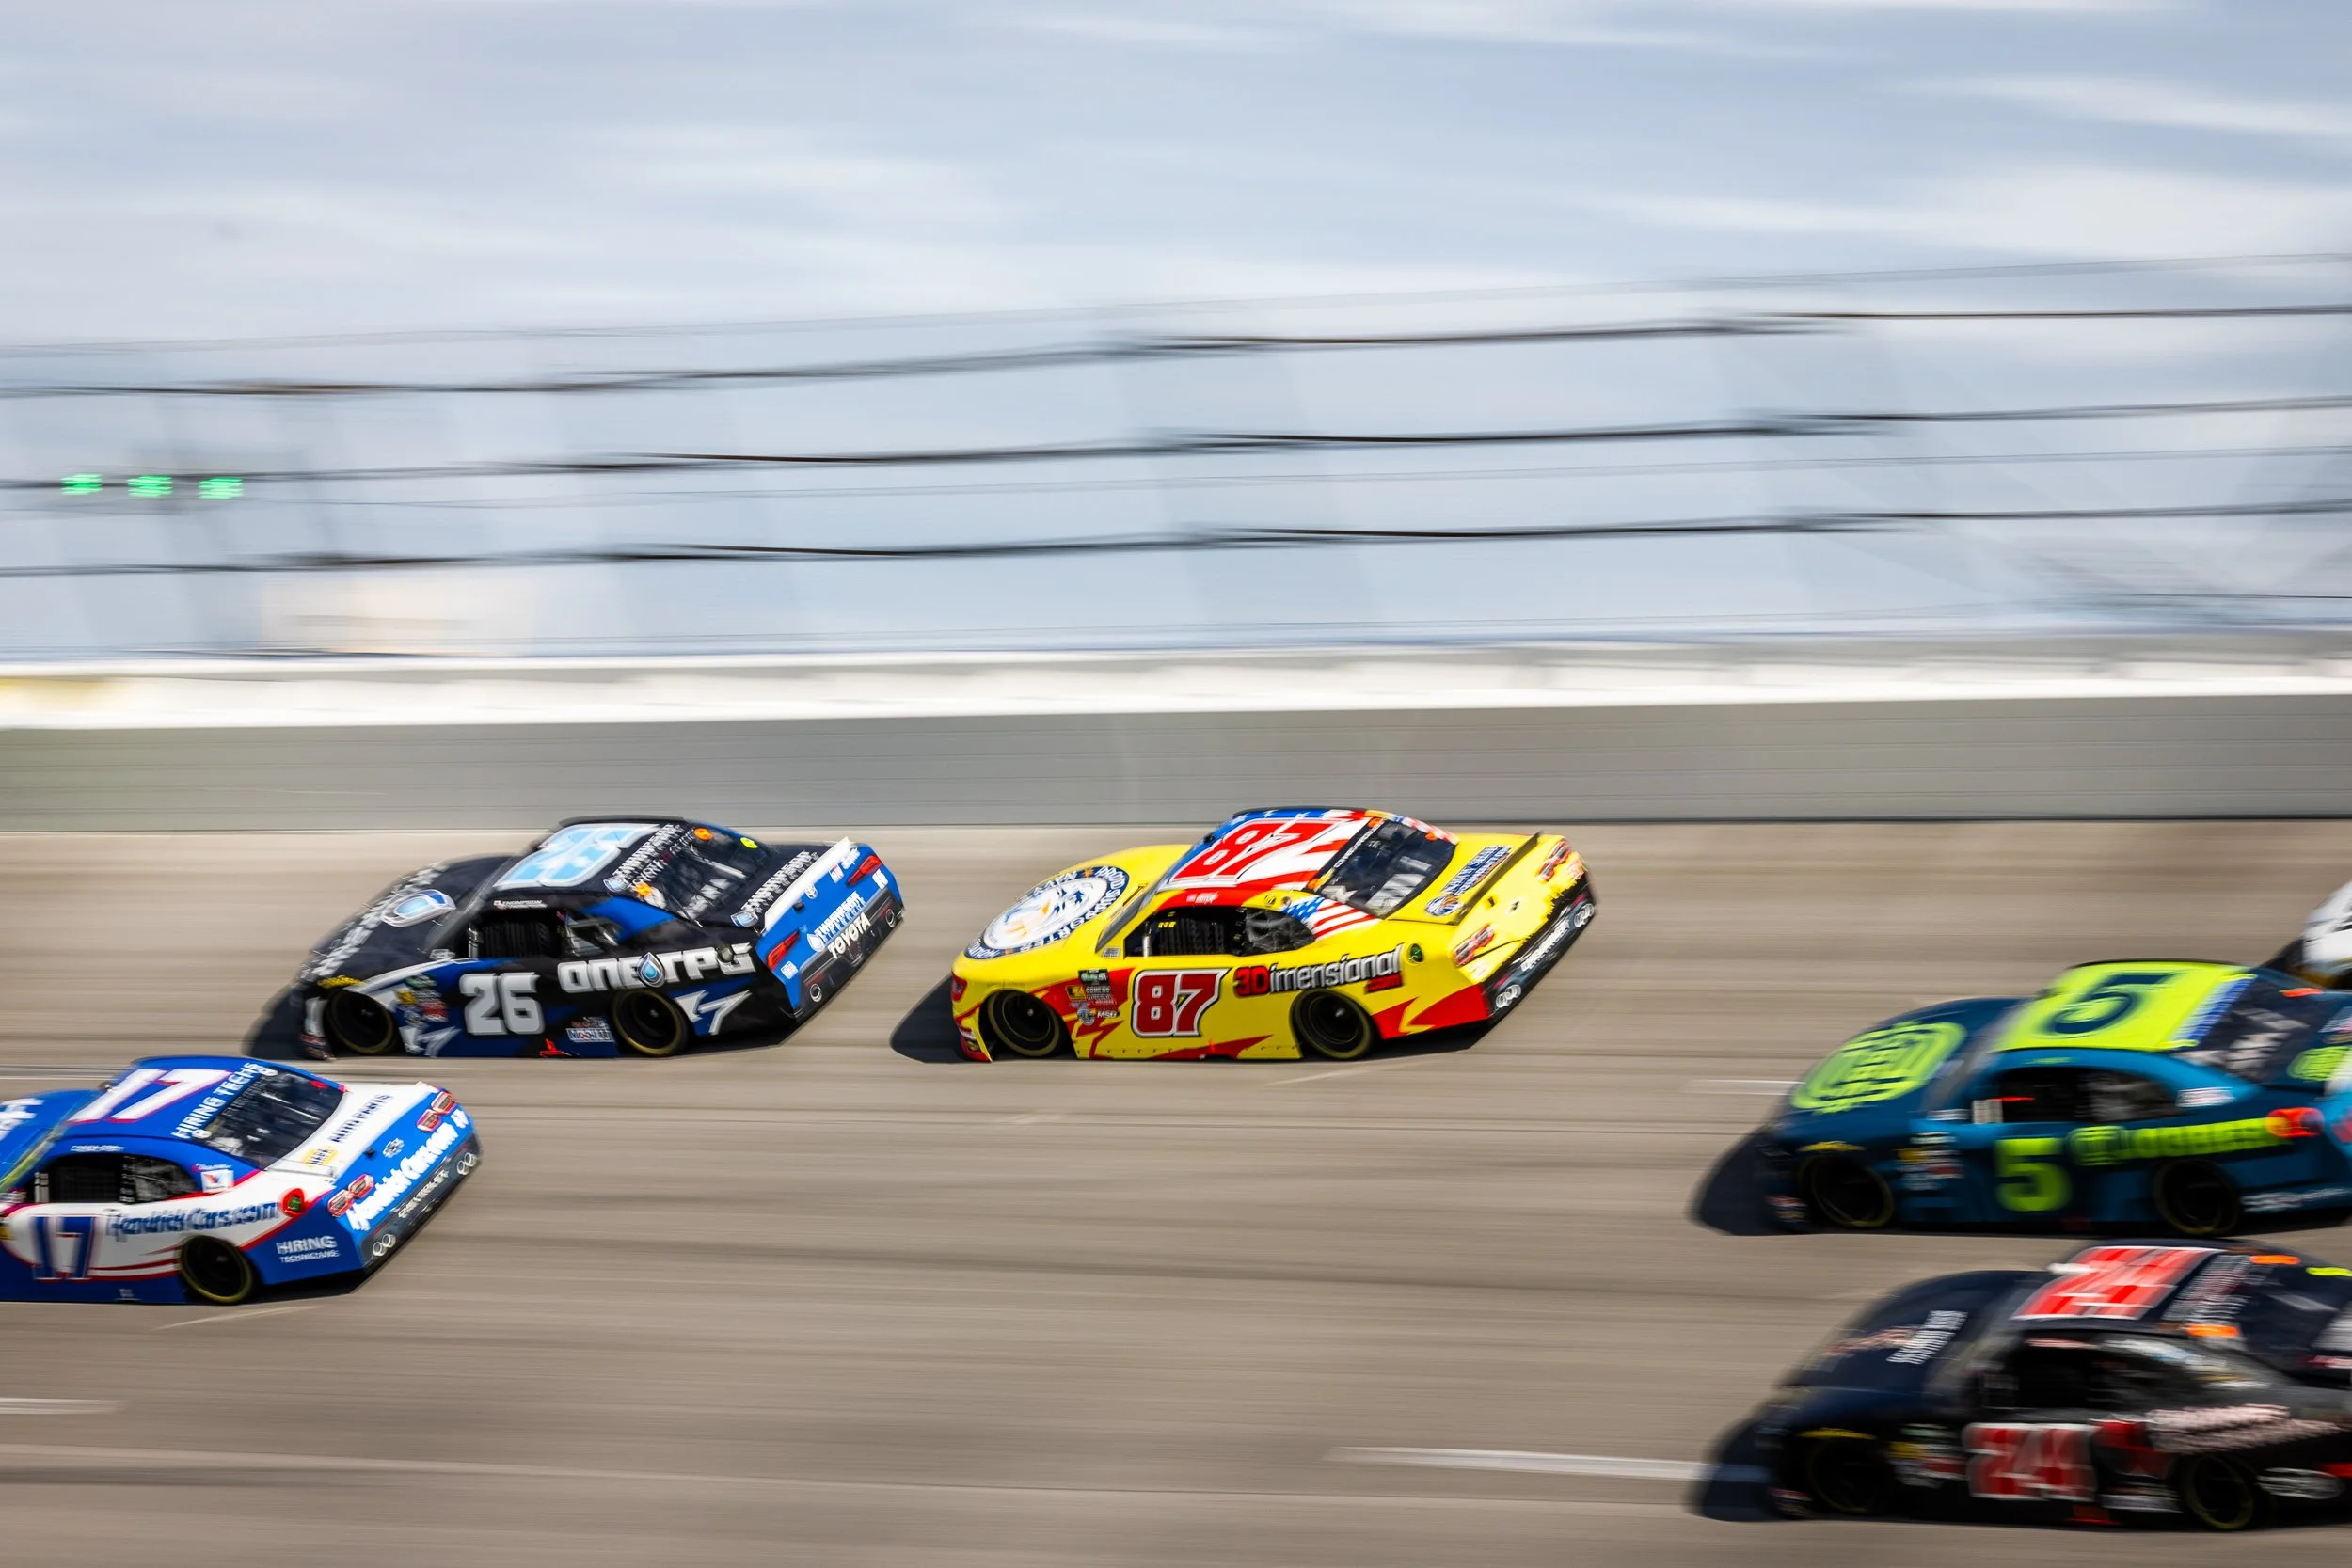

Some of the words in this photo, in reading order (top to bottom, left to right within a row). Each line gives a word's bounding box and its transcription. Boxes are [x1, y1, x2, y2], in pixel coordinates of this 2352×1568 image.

[1171, 819, 1338, 881] 87
[827, 912, 871, 958] TOYOTA
[1234, 943, 1403, 997] 3Dimensional
[459, 972, 546, 1035] 26
[1132, 968, 1232, 1037] 87
[67, 1069, 234, 1123] 17
[171, 1097, 226, 1139] HIRING
[1996, 1138, 2069, 1212] 5
[31, 1213, 102, 1280] 17
[277, 1235, 338, 1254] HIRING
